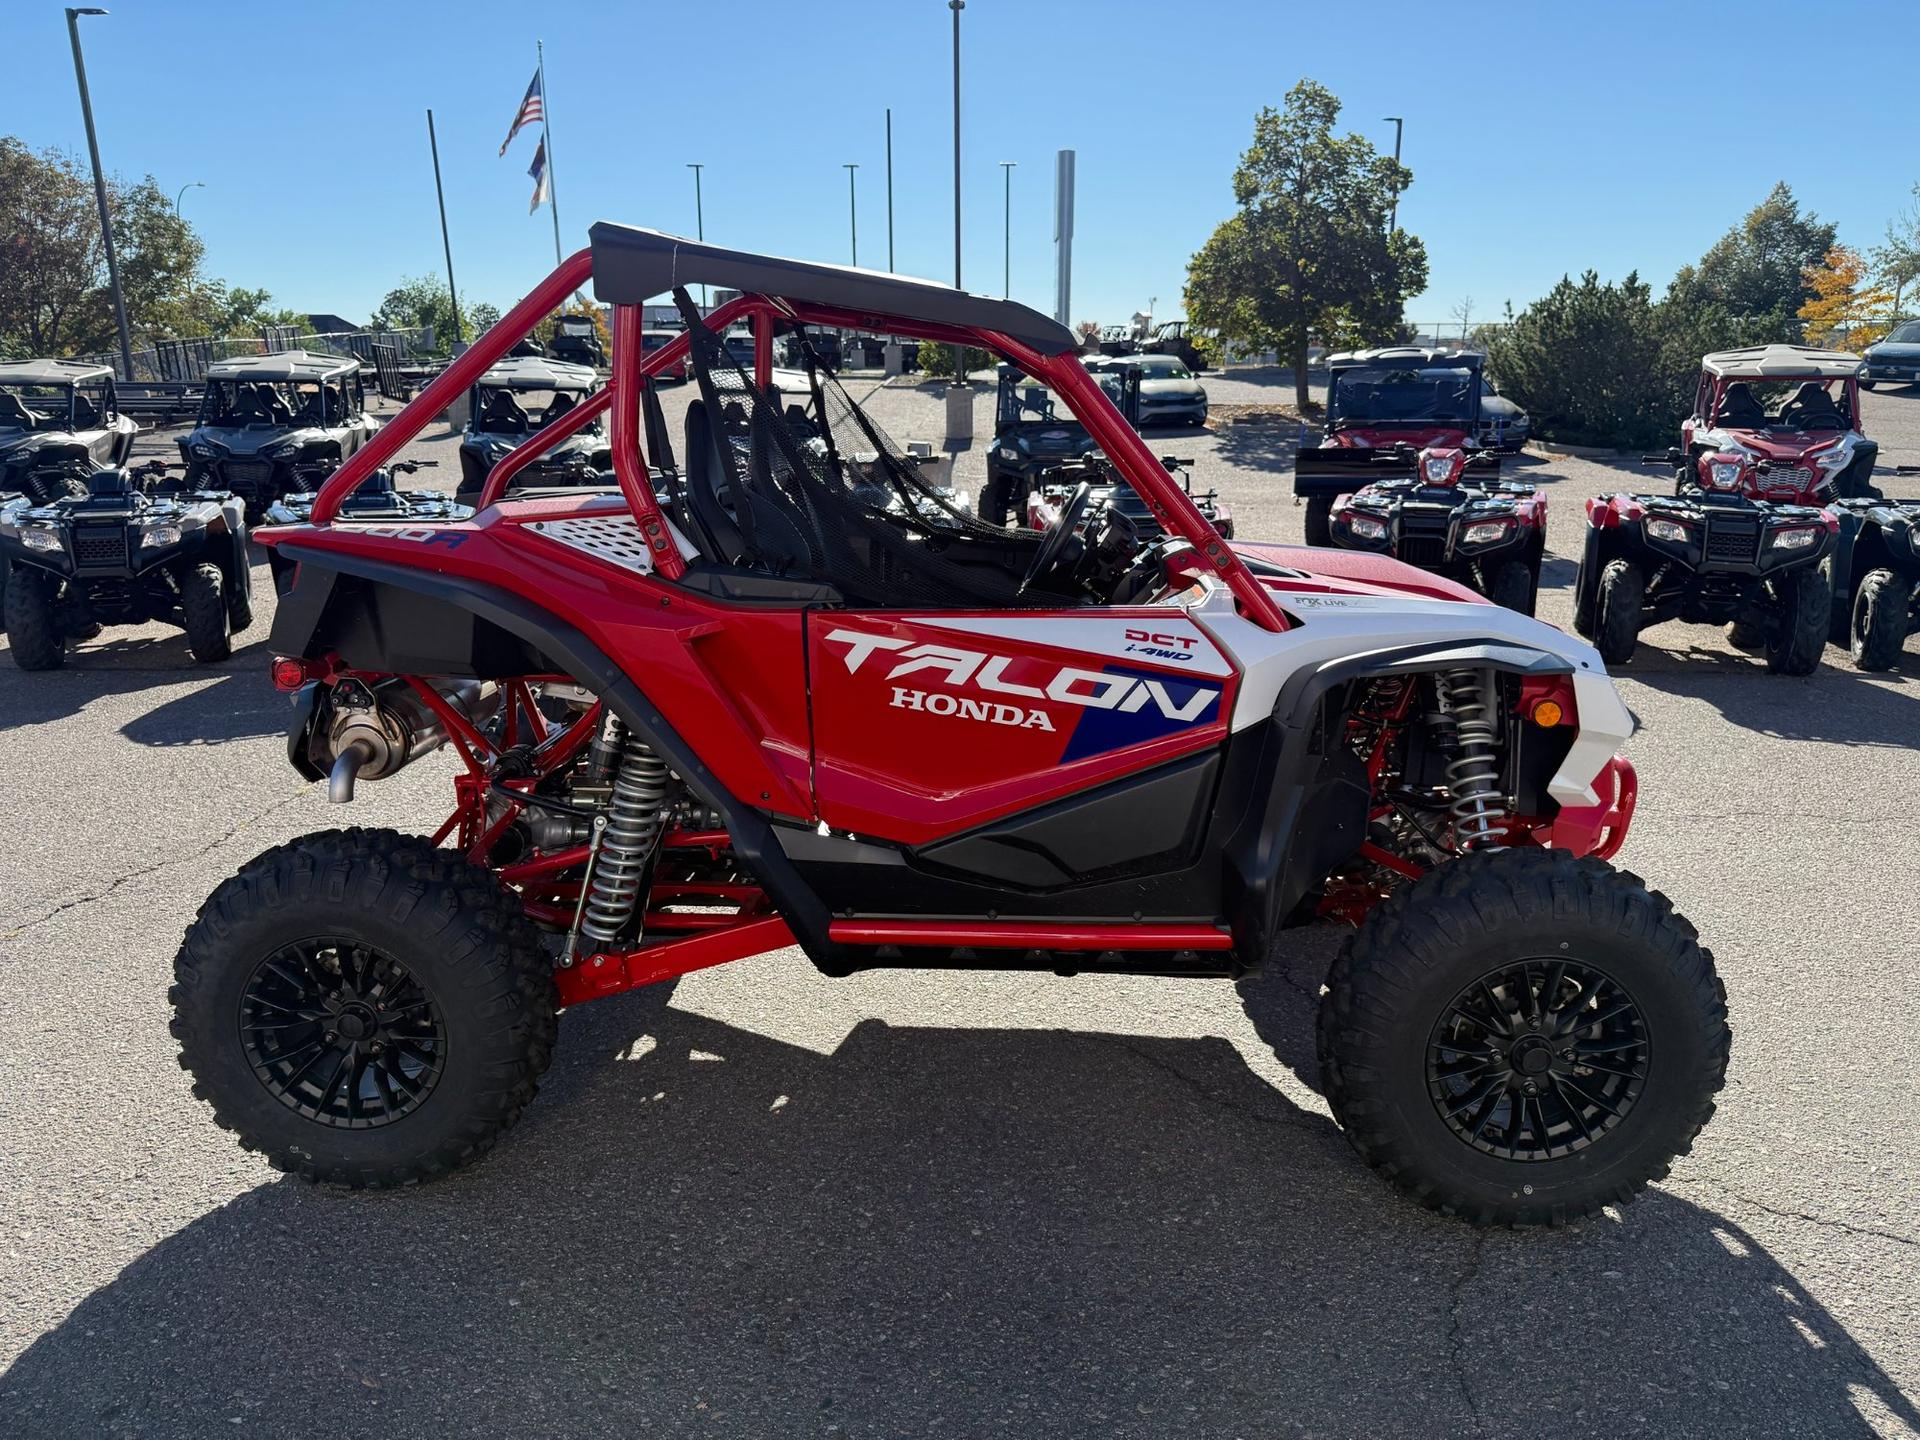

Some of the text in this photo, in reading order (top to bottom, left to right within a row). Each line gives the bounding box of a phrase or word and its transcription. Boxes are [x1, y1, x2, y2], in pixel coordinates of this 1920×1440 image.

[1124, 643, 1194, 661] i-4WD
[1125, 629, 1199, 650] DCT
[824, 629, 1220, 722] TALON
[888, 686, 1057, 732] HONDA
